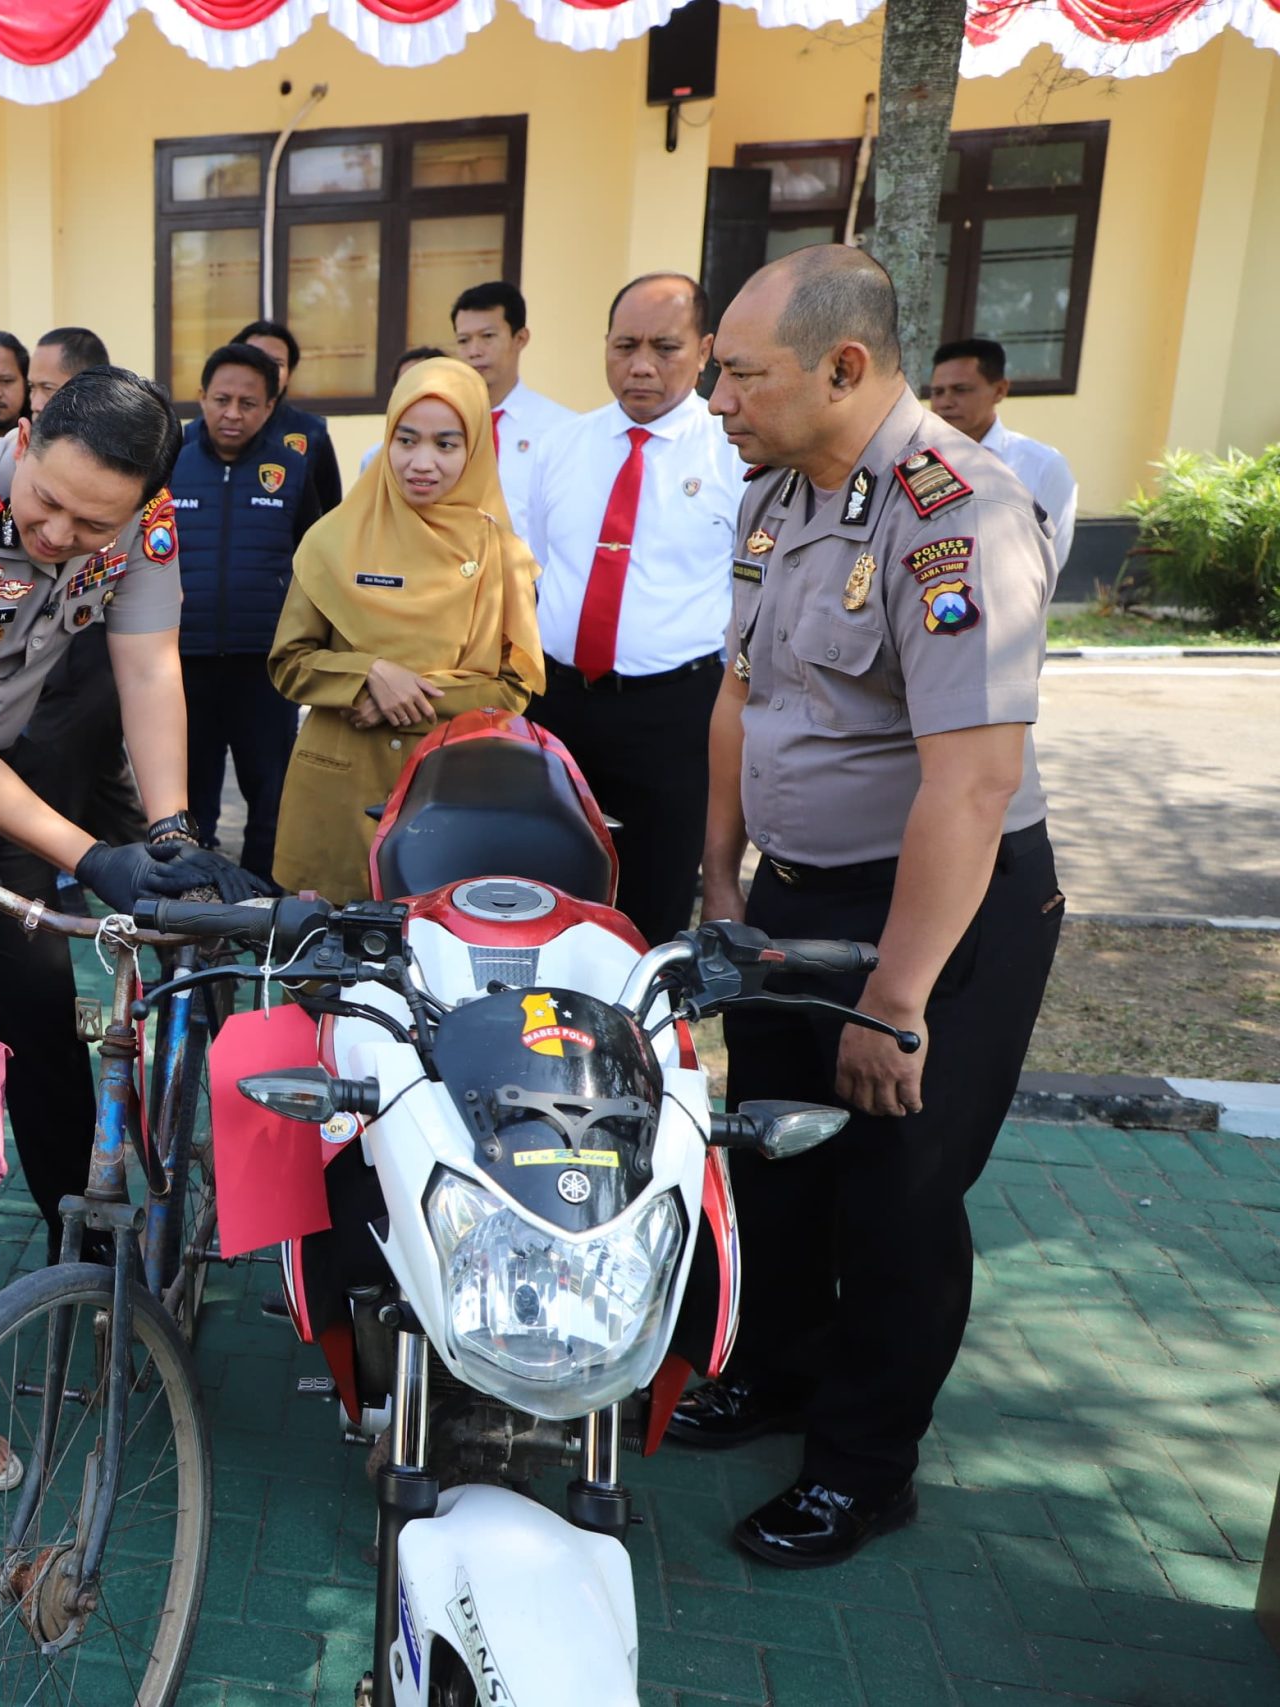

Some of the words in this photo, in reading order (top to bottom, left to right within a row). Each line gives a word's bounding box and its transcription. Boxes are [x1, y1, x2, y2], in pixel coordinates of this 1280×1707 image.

[251, 496, 284, 508] POLRI
[913, 539, 964, 560] POLRES
[912, 548, 969, 571] MAGETAN
[920, 566, 941, 581] JAWA
[942, 562, 965, 574] TIMUR
[522, 1027, 560, 1045] MABES
[562, 1027, 593, 1046] POLRI
[330, 1123, 346, 1134] OK
[554, 1149, 614, 1164] Rcing
